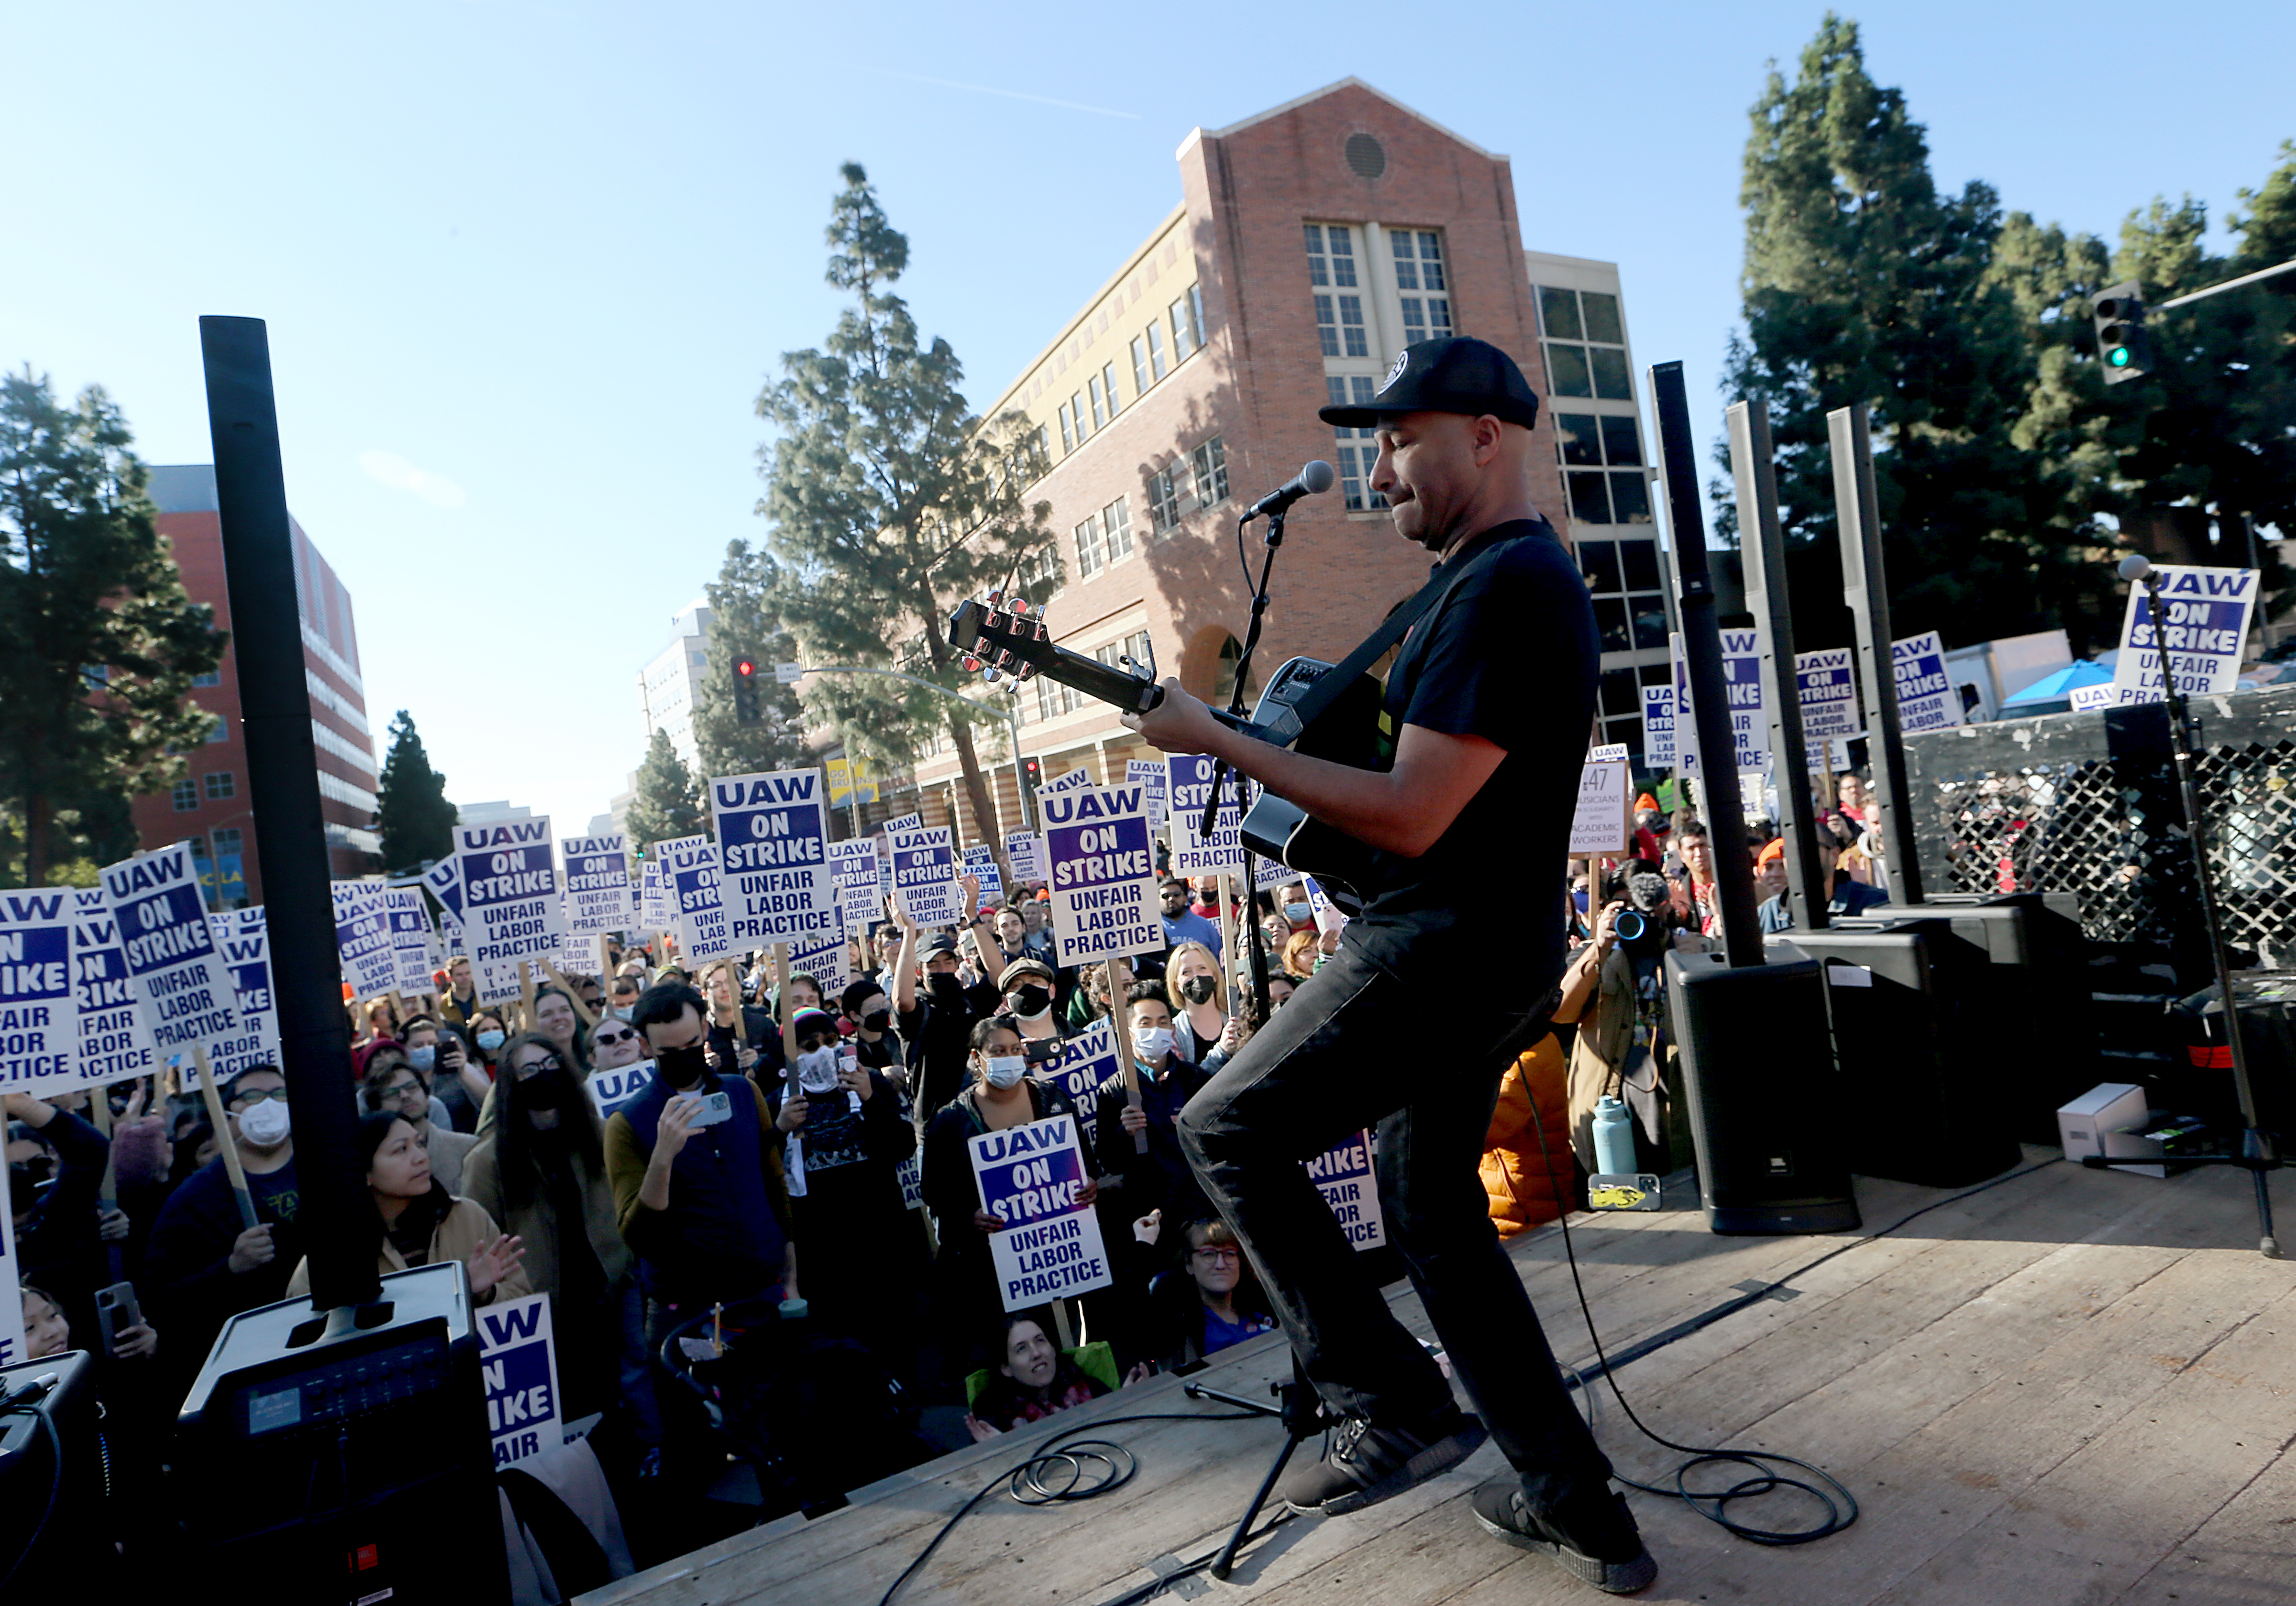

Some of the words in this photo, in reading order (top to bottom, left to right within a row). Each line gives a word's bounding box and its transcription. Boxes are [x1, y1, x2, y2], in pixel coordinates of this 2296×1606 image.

[2167, 602, 2211, 625] ON
[1893, 637, 1932, 658] AW
[1807, 671, 1832, 687] ON
[1893, 660, 1922, 682] ON
[1647, 689, 1673, 701] UA
[1802, 704, 1845, 716] UNFAIR
[1647, 717, 1674, 731] STR
[1806, 715, 1845, 727] LABOR
[1655, 734, 1674, 742] UNF
[1656, 743, 1675, 752] LAB
[1595, 746, 1623, 757] UAW
[1649, 753, 1676, 762] PRAC
[830, 769, 846, 779] GO
[1131, 762, 1165, 773] UAW
[1139, 775, 1155, 786] ON
[717, 775, 815, 808] UAW
[1147, 786, 1164, 798] IKE
[1045, 788, 1141, 823] UAW
[751, 811, 790, 838] ON
[887, 815, 916, 832] UAW
[464, 822, 546, 849] UAW
[565, 836, 622, 854] UAW
[894, 830, 948, 848] UAW
[1008, 833, 1032, 842] UAW
[1079, 825, 1117, 854] ON
[1572, 834, 1618, 844] WORKERS
[726, 836, 822, 869] STRIKE
[829, 842, 872, 858] UAW
[963, 847, 988, 858] UAW
[1016, 842, 1027, 851] ON
[491, 850, 525, 874] ON
[584, 857, 607, 873] ON
[675, 847, 717, 868] UA
[842, 858, 861, 872] ON
[912, 849, 935, 866] ON
[1056, 850, 1149, 886] STRIKE
[1180, 848, 1246, 869] PRACTIC
[108, 852, 183, 898] UAW
[199, 870, 243, 886] CLA
[569, 871, 626, 891] STRIKE
[740, 871, 814, 895] UNFAIR
[831, 869, 876, 886] STRIKE
[897, 863, 952, 885] STRIKE
[469, 869, 553, 902] STRIKE
[845, 889, 872, 900] NFAIR
[906, 885, 947, 900] UNFAIR
[386, 894, 417, 909] UAW
[578, 891, 620, 905] UNFAIR
[746, 892, 812, 916] LABOR
[845, 899, 872, 911] ABOR
[909, 898, 946, 912] LABOR
[1070, 884, 1141, 911] UNFAIR
[138, 895, 174, 930] ON
[483, 901, 546, 924] UNFAIR
[581, 903, 620, 916] LABOR
[1076, 905, 1141, 932] LABOR
[353, 916, 379, 937] ON
[489, 919, 544, 941] LABOR
[573, 914, 631, 930] PRACTICE
[733, 911, 831, 939] PRACTICE
[128, 919, 209, 968] STRIKE
[567, 939, 590, 948] FAIR
[699, 925, 726, 941] LAB
[1064, 924, 1159, 956] PRACTICE
[477, 933, 561, 961] PRACTICE
[692, 939, 728, 957] PRAC
[356, 951, 392, 970] UNFAI
[2, 962, 66, 995] IKE
[147, 964, 210, 998] UNFAIR
[363, 963, 394, 981] LABO
[358, 974, 396, 996] PRACT
[482, 986, 521, 1001] PRACT
[821, 975, 846, 992] TICE
[157, 989, 214, 1022] LABOR
[78, 1011, 134, 1036] FAIR
[154, 1008, 237, 1048] PRACTICE
[79, 1032, 132, 1057] BOR
[207, 1035, 262, 1060] ABOR
[596, 1066, 654, 1100] UA
[1068, 1064, 1098, 1094] ON
[978, 1120, 1068, 1163] UAW
[1012, 1157, 1051, 1189] ON
[992, 1178, 1082, 1222] STRIKE
[1010, 1218, 1082, 1253] UNFAIR
[1018, 1241, 1083, 1274] LABOR
[1007, 1258, 1104, 1300] PRACTICE
[487, 1384, 550, 1431] IKE
[493, 1432, 540, 1467] AIR
